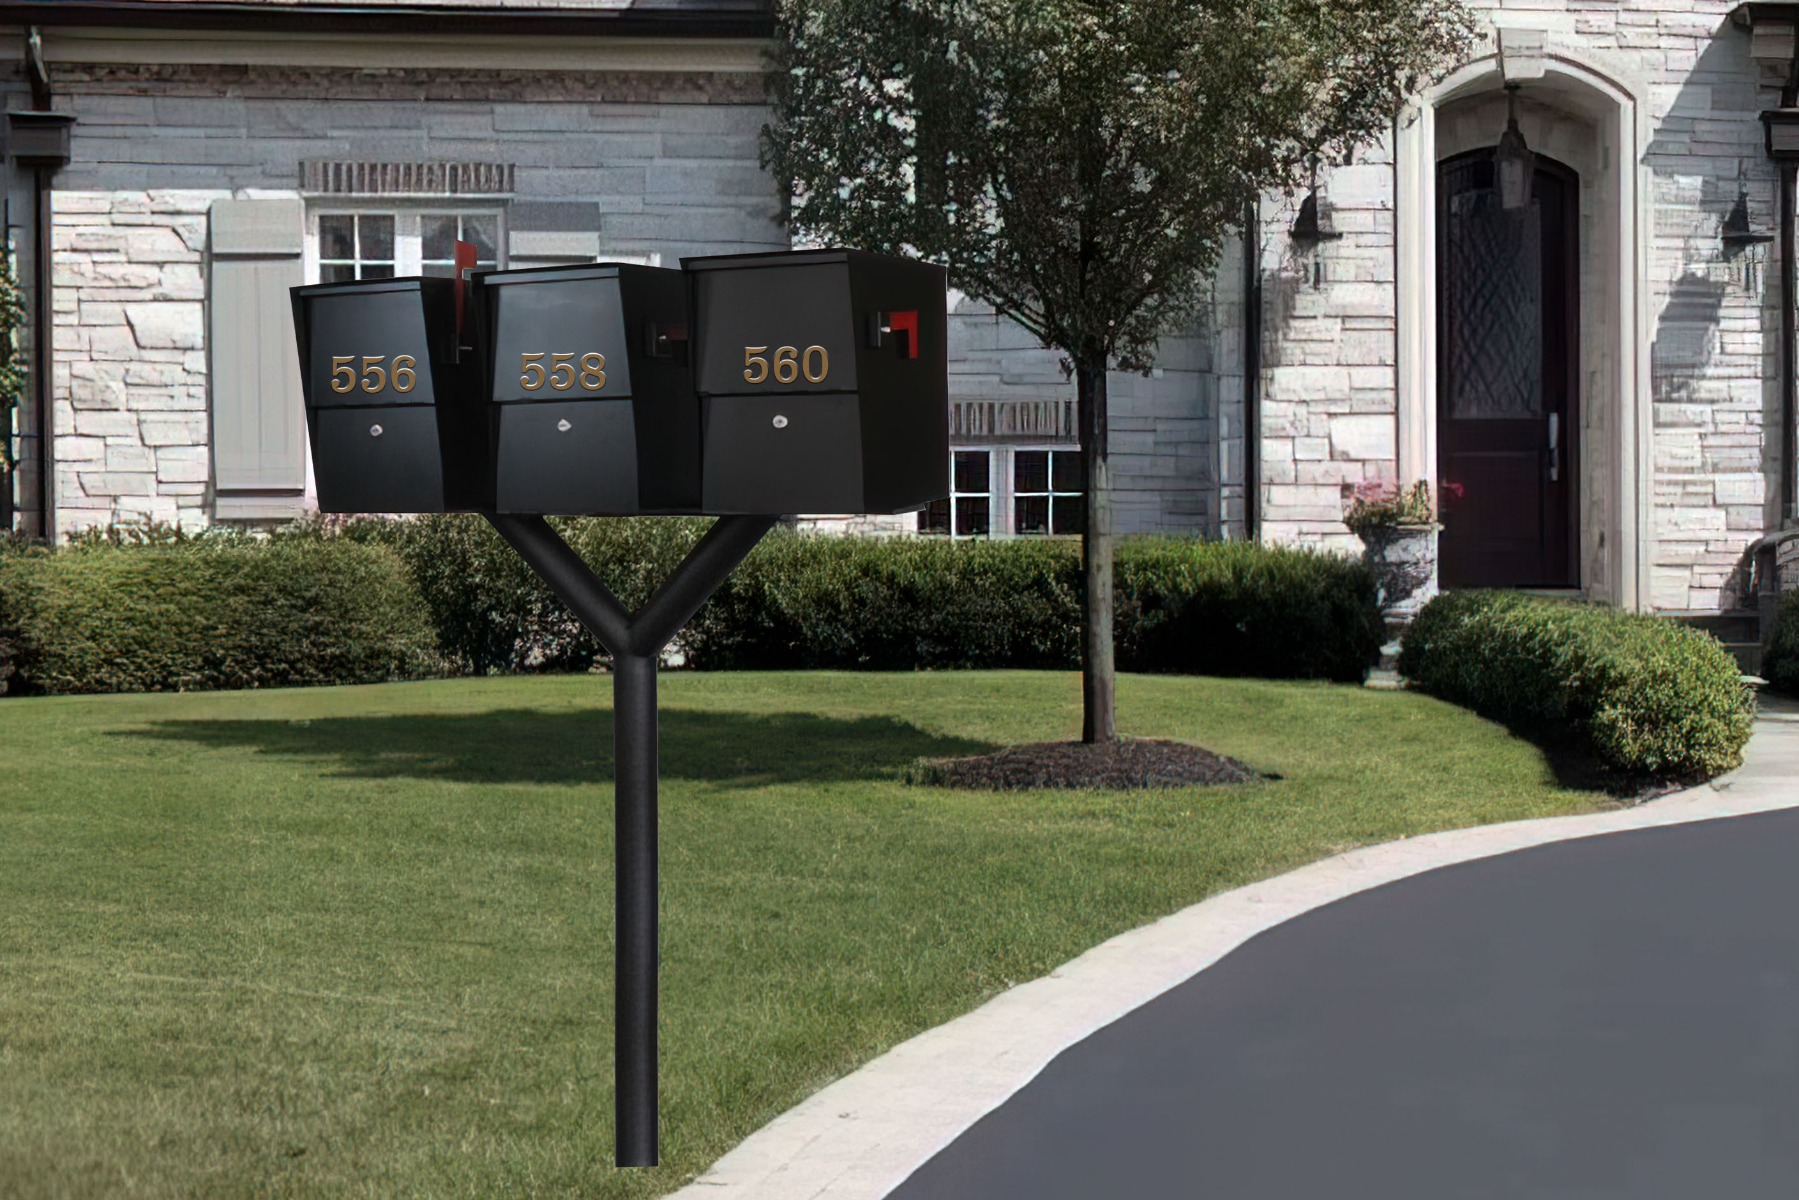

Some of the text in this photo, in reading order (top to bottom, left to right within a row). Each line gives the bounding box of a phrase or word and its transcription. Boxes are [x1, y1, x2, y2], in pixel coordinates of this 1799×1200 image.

[330, 354, 417, 393] 556
[519, 352, 607, 392] 558
[743, 345, 829, 384] 560
